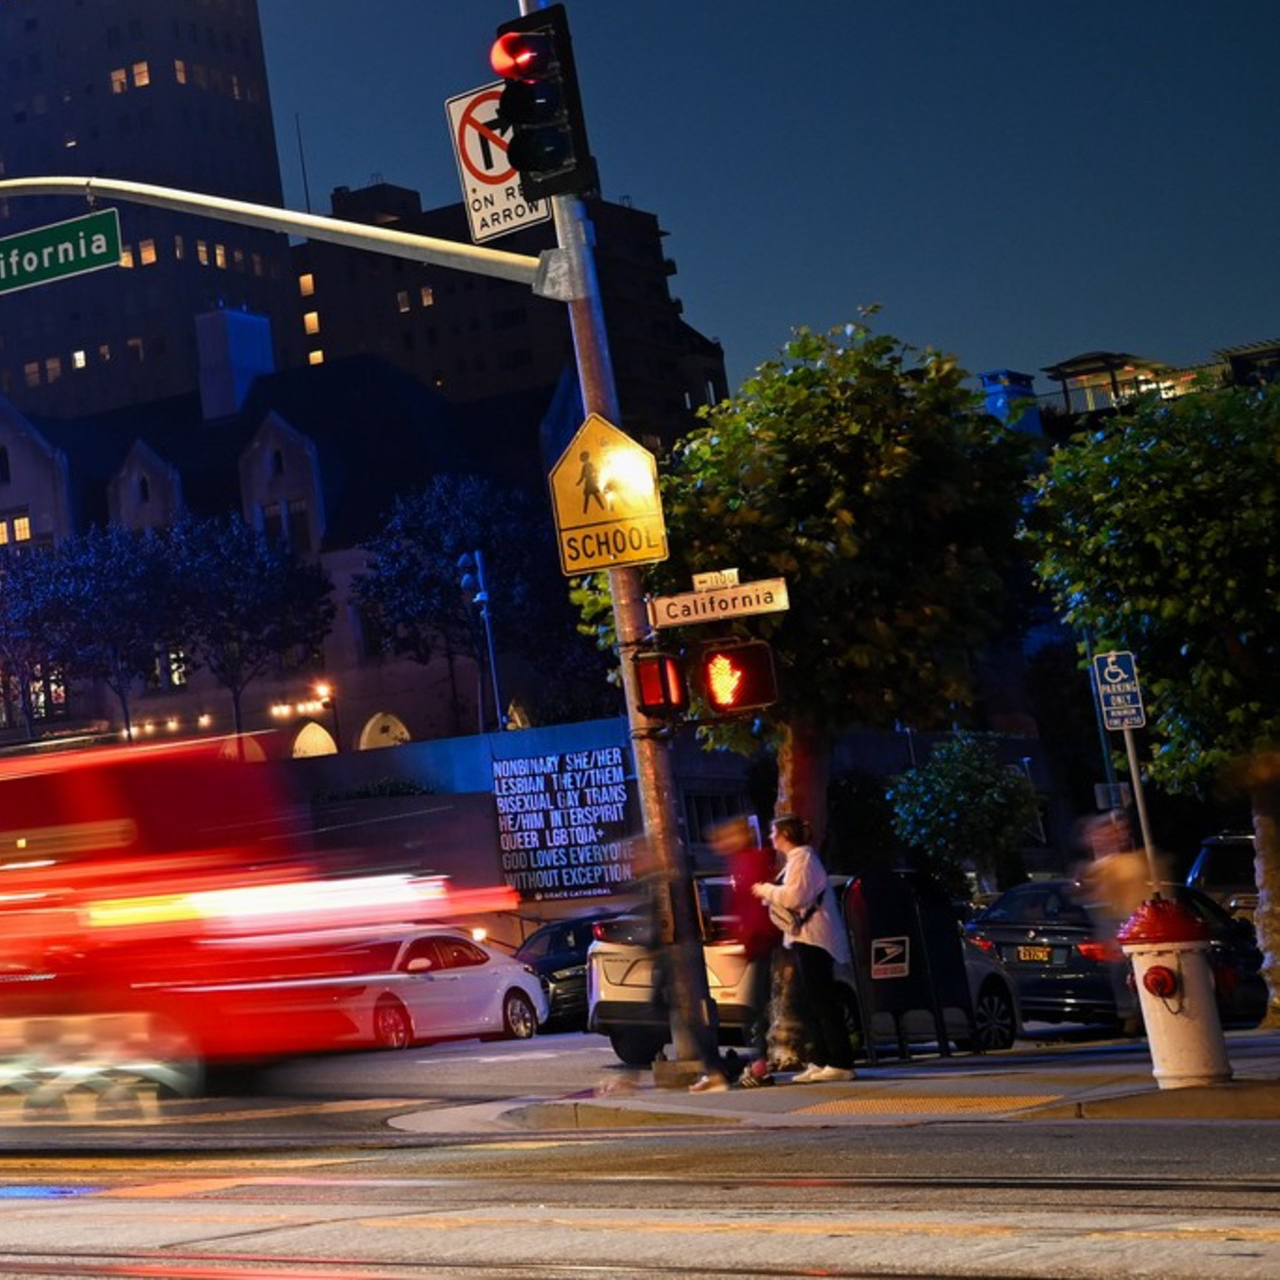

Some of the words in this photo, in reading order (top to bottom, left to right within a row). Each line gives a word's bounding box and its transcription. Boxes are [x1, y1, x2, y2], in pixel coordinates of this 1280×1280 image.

[472, 194, 494, 213] ON
[480, 201, 539, 231] ARROW
[566, 525, 660, 562] SCHOOL
[665, 589, 774, 620] California
[1101, 682, 1137, 693] PARKING
[1111, 694, 1131, 706] ONLY
[493, 755, 560, 778] NONBINARY
[566, 747, 622, 770] SHE/HER
[494, 776, 545, 795] LESBIAN
[552, 767, 624, 791] THEY/THEM
[496, 794, 554, 814] BISEXUAL
[557, 791, 580, 808] GAY
[585, 785, 627, 804] TRANS
[498, 813, 545, 832] HE/HIM
[550, 803, 624, 828] INTERSPIRIT
[500, 830, 539, 850] QUEER
[546, 827, 604, 847] LGBTQIA+
[502, 852, 528, 869] GOD
[530, 848, 567, 868] LOVES
[569, 841, 634, 865] EVERYONE
[504, 869, 560, 890] WITHOUT
[562, 864, 637, 886] EXCEPTION.
